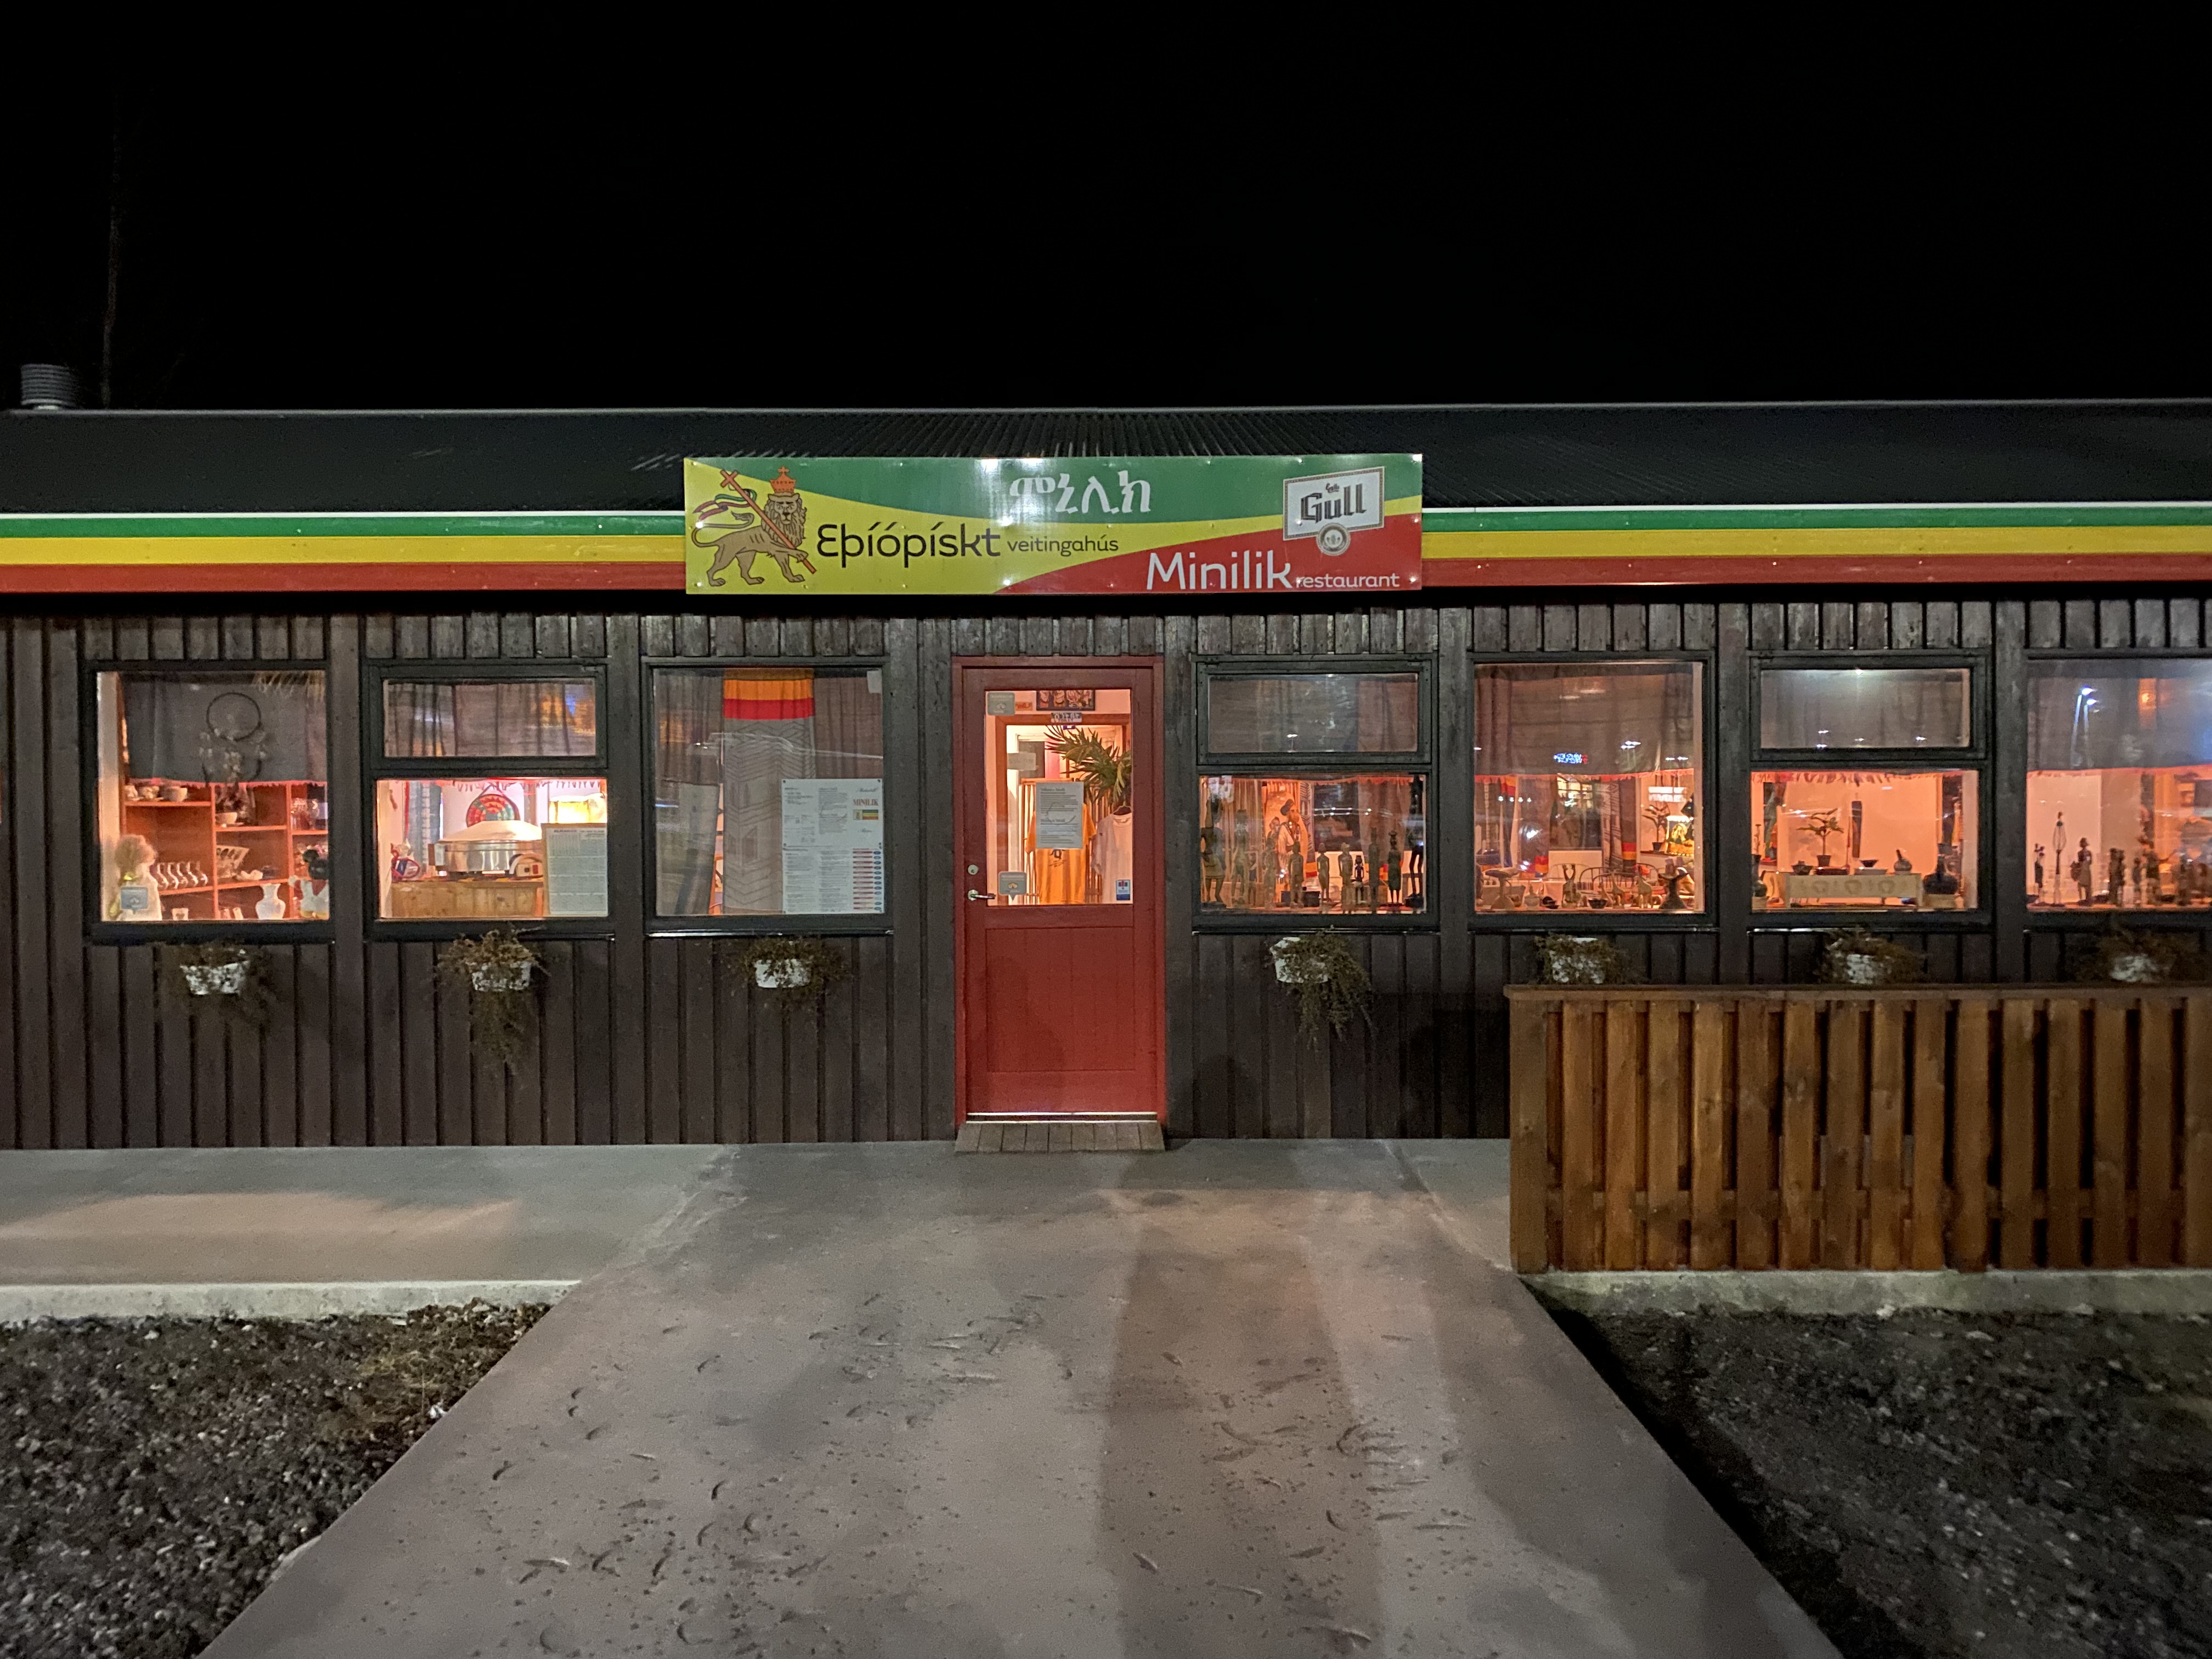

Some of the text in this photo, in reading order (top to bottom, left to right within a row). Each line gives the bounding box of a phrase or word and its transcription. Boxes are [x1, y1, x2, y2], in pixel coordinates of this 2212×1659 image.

[1301, 483, 1367, 523] Gull
[1007, 534, 1119, 557] veitingahús
[1147, 550, 1400, 590] Minilik restaurant
